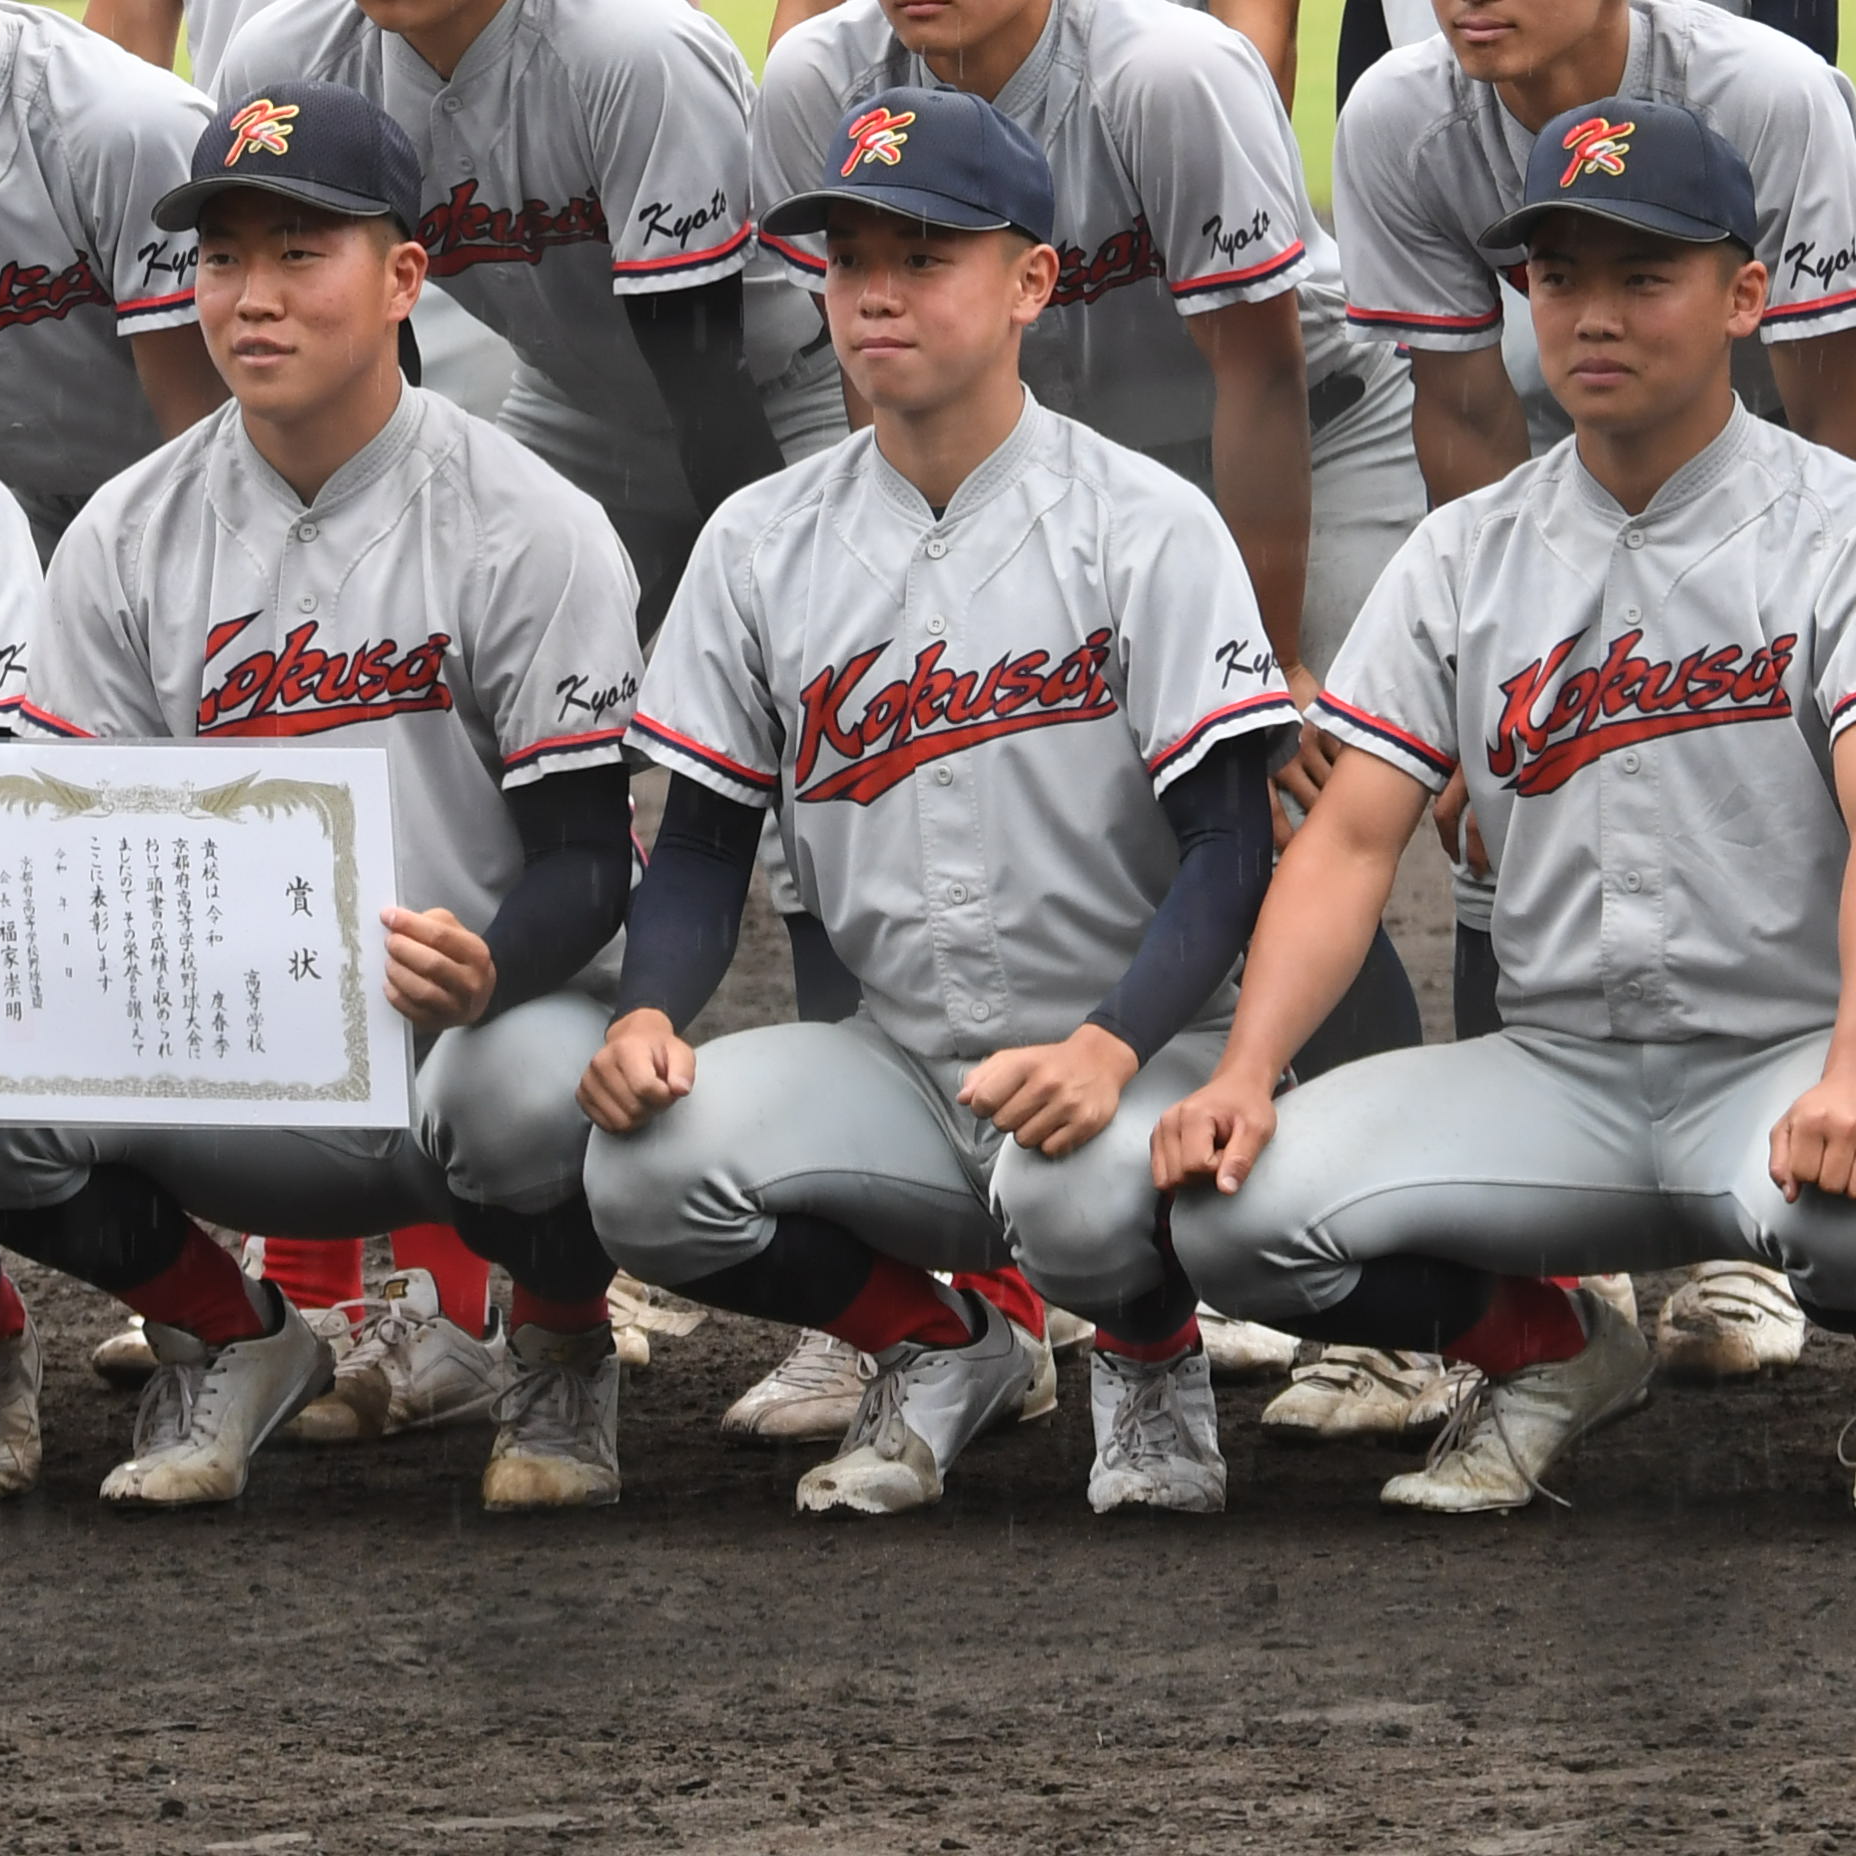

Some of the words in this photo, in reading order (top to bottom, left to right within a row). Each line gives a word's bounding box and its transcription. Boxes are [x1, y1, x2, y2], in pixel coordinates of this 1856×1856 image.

[639, 188, 728, 249] Kyoto
[556, 671, 638, 724] Kyoto
[795, 628, 1119, 806] Kokusai
[1485, 626, 1799, 797] Kokusai
[285, 875, 322, 982] 賞状
[243, 968, 266, 1054] 高等学校
